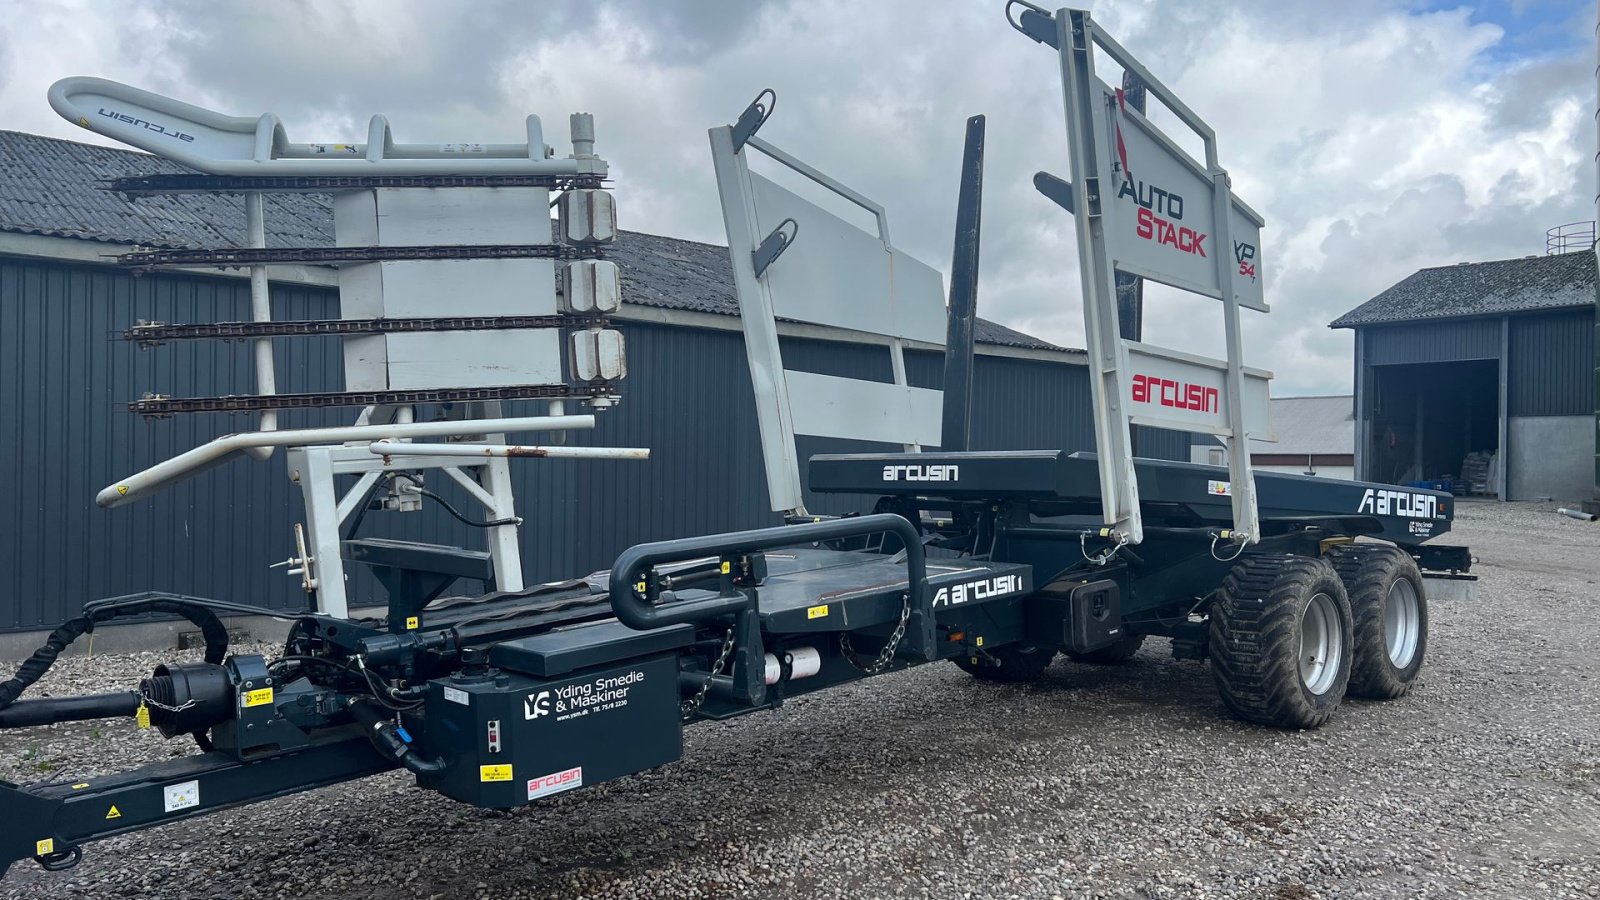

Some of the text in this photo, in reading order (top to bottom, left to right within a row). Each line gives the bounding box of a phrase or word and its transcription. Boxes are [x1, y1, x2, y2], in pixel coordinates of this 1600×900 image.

[98, 108, 195, 142] arcusin
[1118, 171, 1184, 220] AUTO
[1137, 207, 1207, 257] STACK
[1132, 374, 1218, 413] arcusin
[883, 465, 959, 481] arcusin
[1377, 490, 1436, 518] arcusin
[952, 575, 1023, 604] arcusin
[555, 671, 644, 699] Yding Smedie
[556, 687, 629, 713] & Maskiner
[530, 769, 580, 791] arcusin
